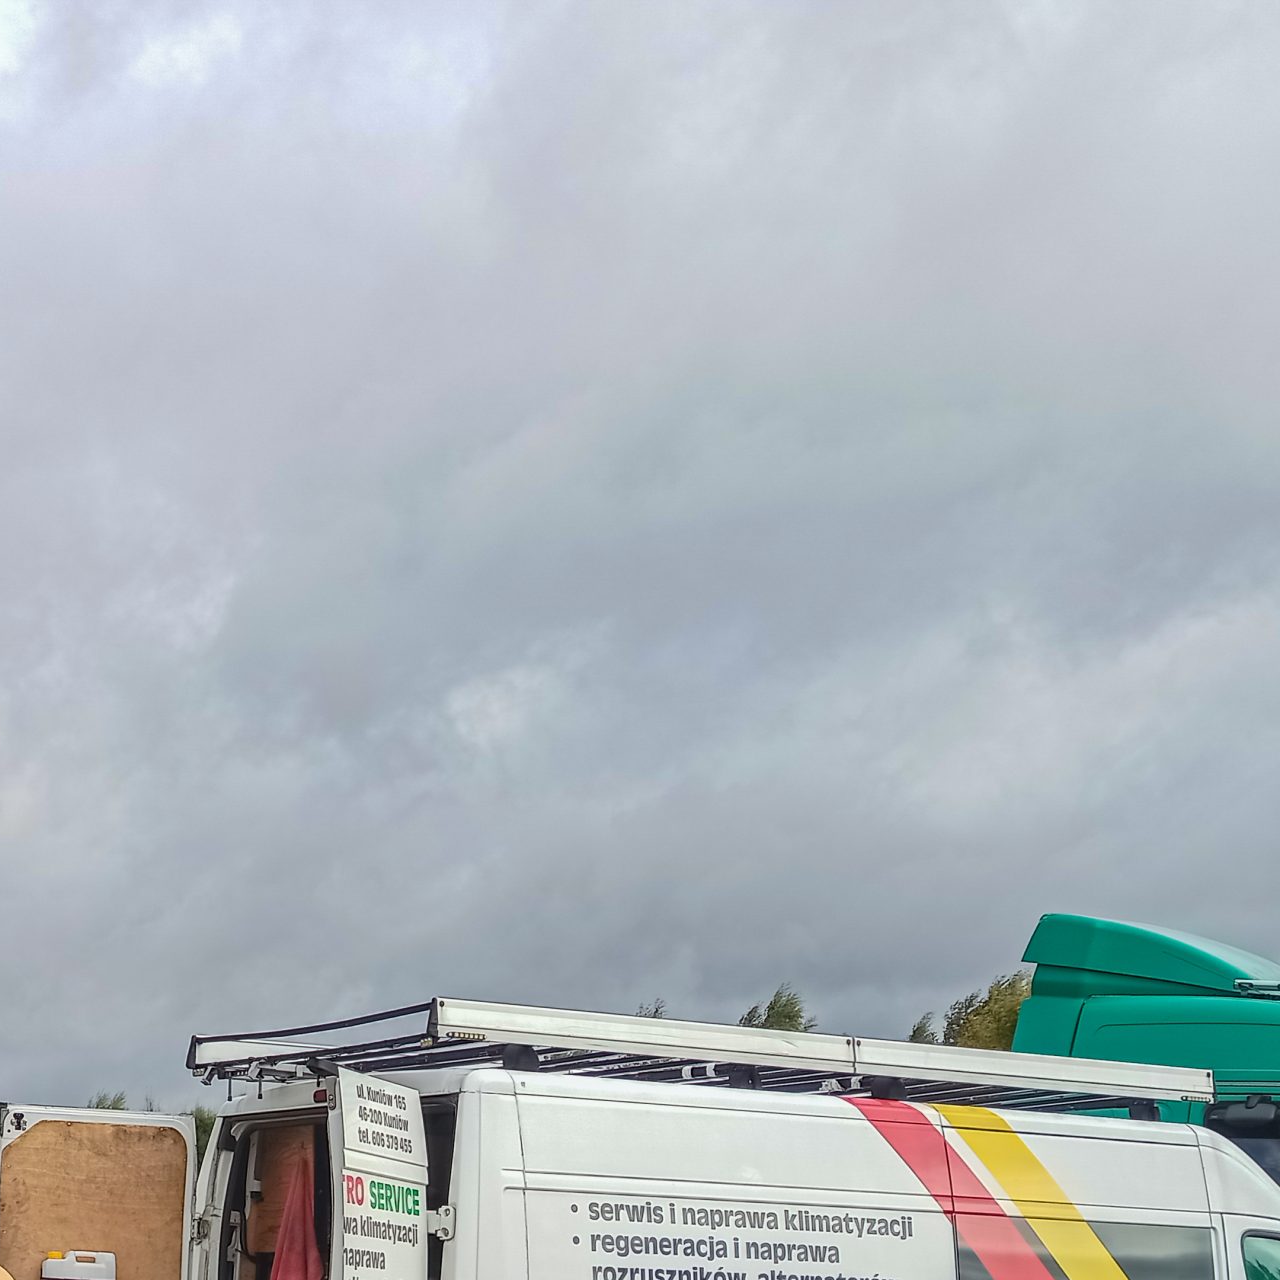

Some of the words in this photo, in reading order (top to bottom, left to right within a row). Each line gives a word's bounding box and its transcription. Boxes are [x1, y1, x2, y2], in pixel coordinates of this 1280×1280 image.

[358, 1105, 382, 1126] 46-200
[394, 1094, 407, 1111] 165
[357, 1126, 371, 1145] tel.
[371, 1130, 385, 1148] 606
[385, 1134, 399, 1151] 379
[399, 1137, 413, 1154] 455
[369, 1180, 420, 1216] SERVICE
[360, 1215, 418, 1248] klimatyzacji
[588, 1201, 664, 1224] serwis
[669, 1202, 676, 1225] i
[681, 1206, 779, 1230] naprawa
[784, 1209, 914, 1240] klimatyzacji
[590, 1233, 728, 1261] regeneracja
[733, 1236, 740, 1259] i
[745, 1240, 840, 1265] naprawa
